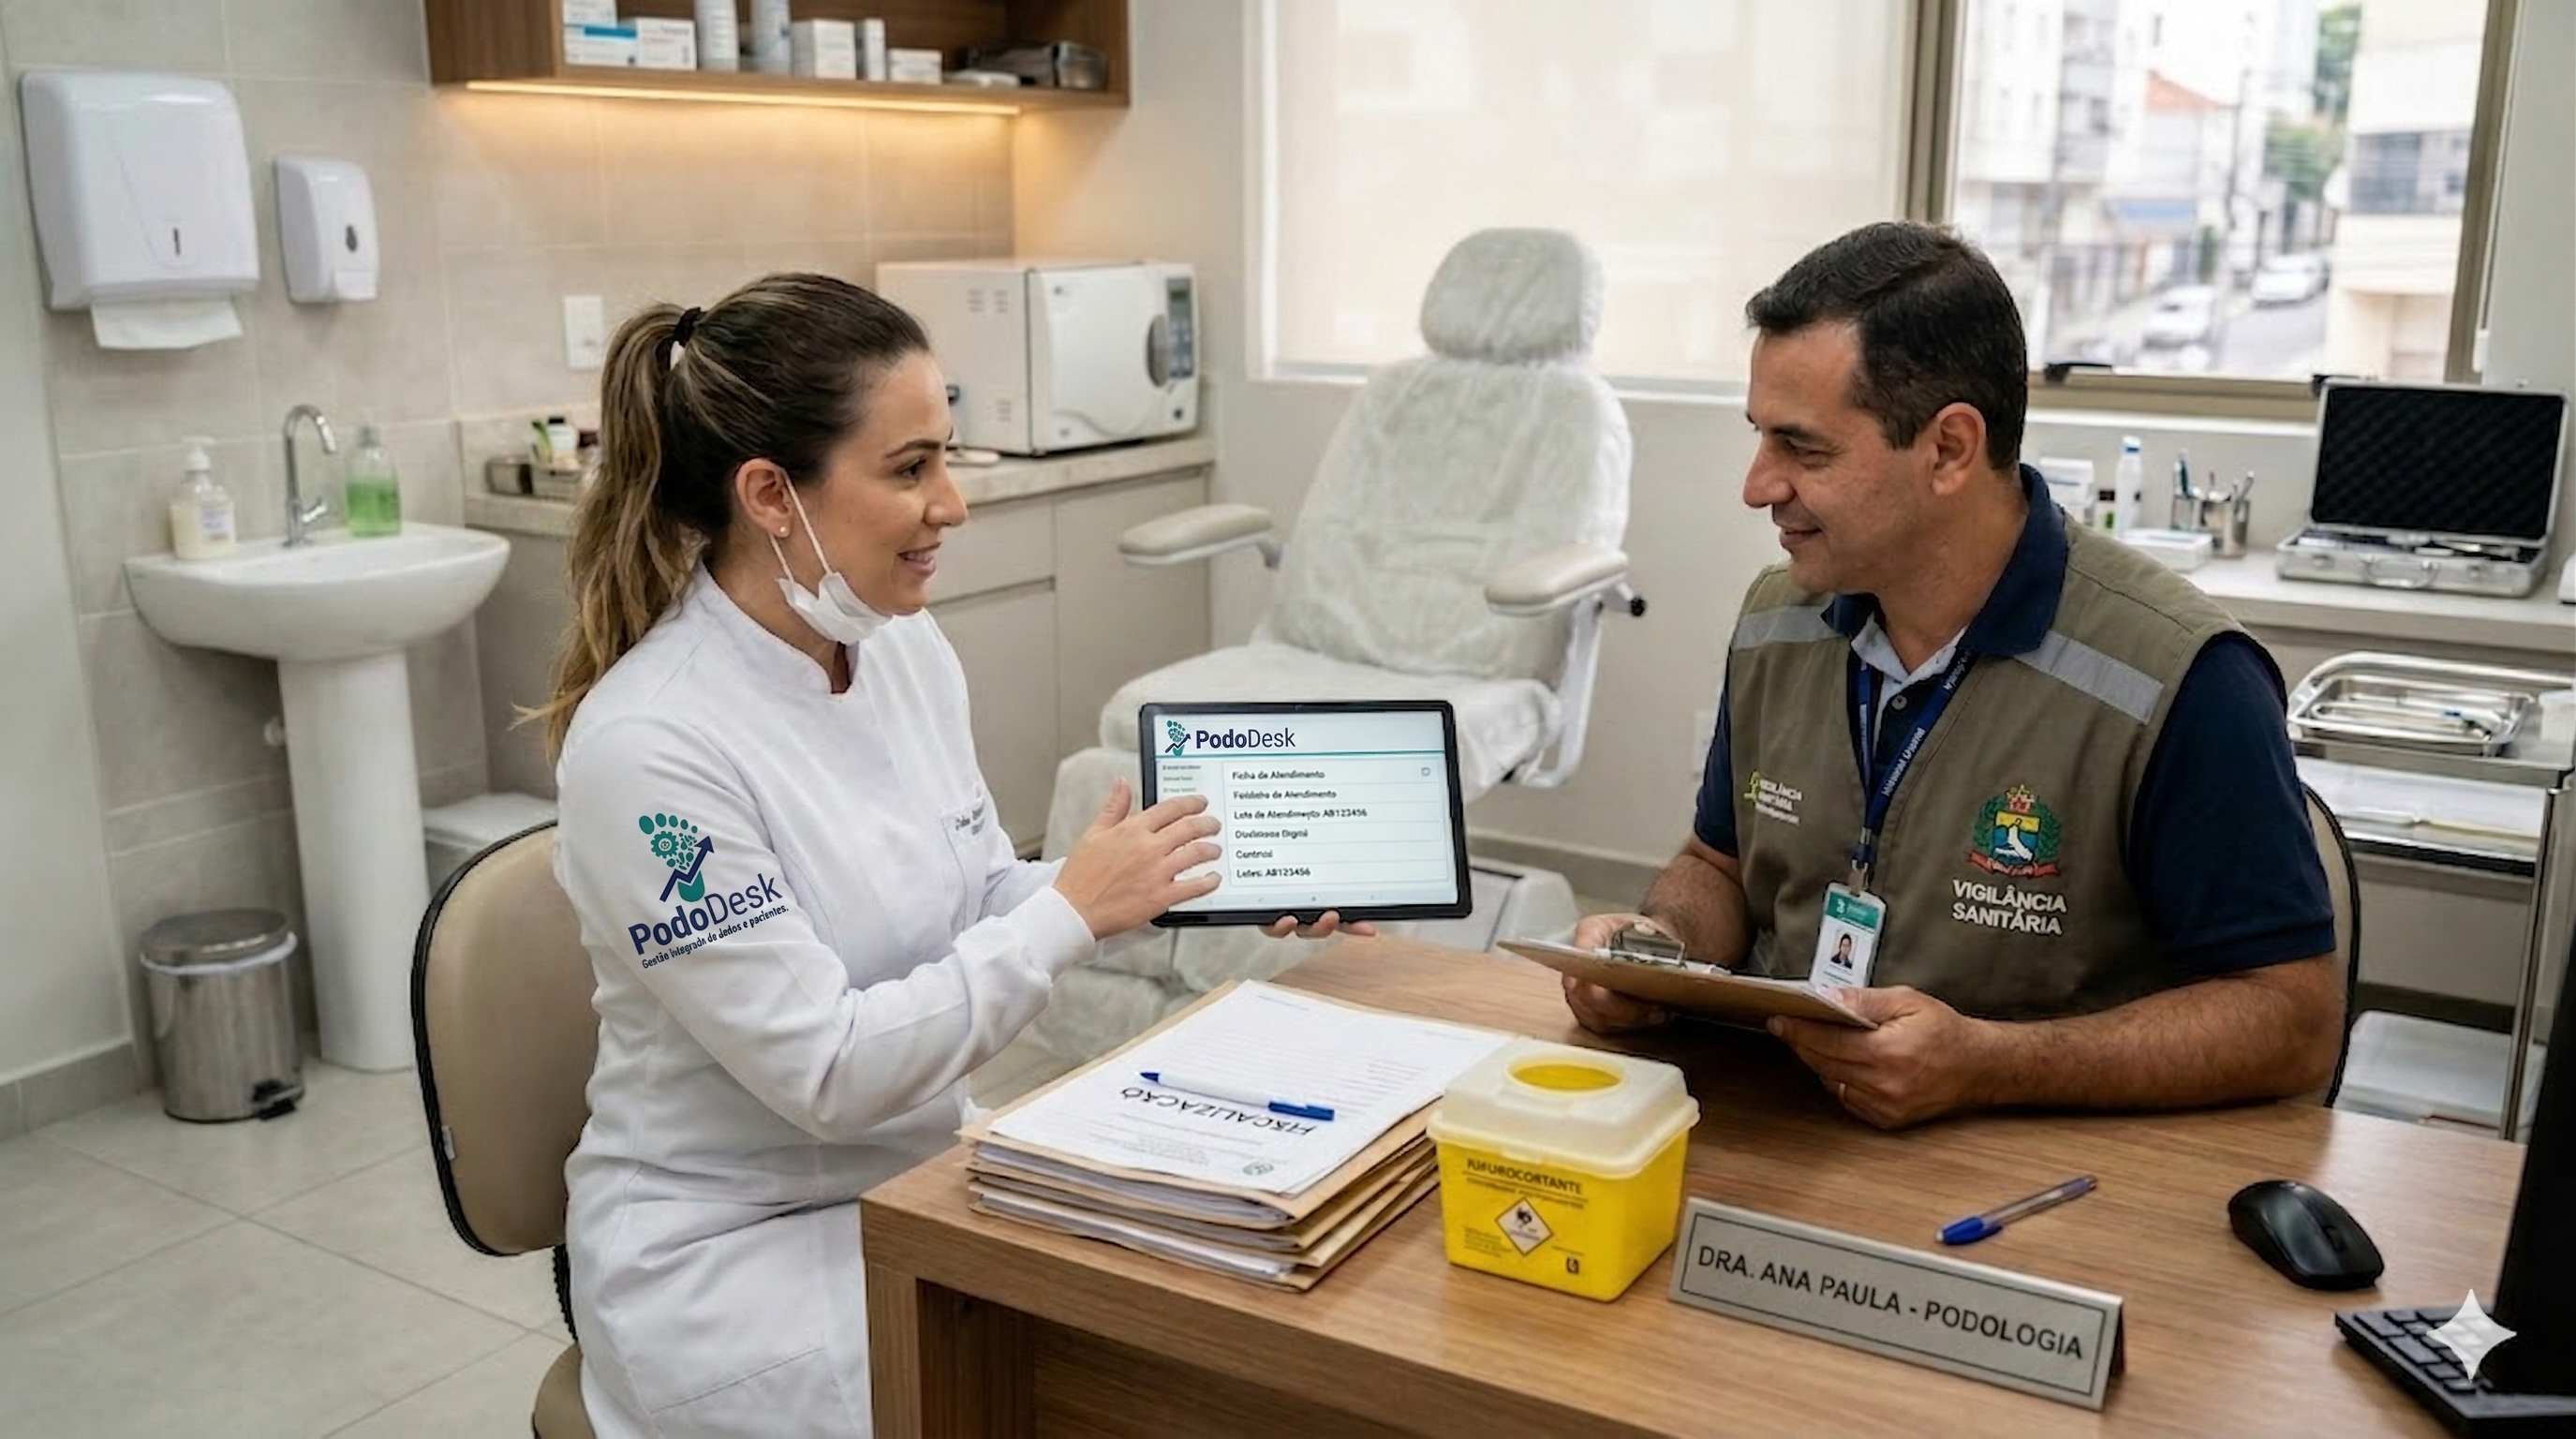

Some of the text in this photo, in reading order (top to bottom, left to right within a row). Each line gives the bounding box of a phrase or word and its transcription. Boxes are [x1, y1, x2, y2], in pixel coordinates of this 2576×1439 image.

[1196, 727, 1295, 749] PodoDesk
[1953, 879, 2067, 913] VIGILÂNCIA
[628, 873, 783, 956] PodoDesk
[1952, 901, 2063, 935] SANITÁRIA
[642, 951, 670, 969] Gestão
[707, 932, 718, 943] de
[1698, 1245, 1754, 1279] DRA.
[1759, 1262, 1813, 1293] ANA
[1819, 1274, 1902, 1314] PAULA
[1924, 1299, 2083, 1359] PODOLOGIA
